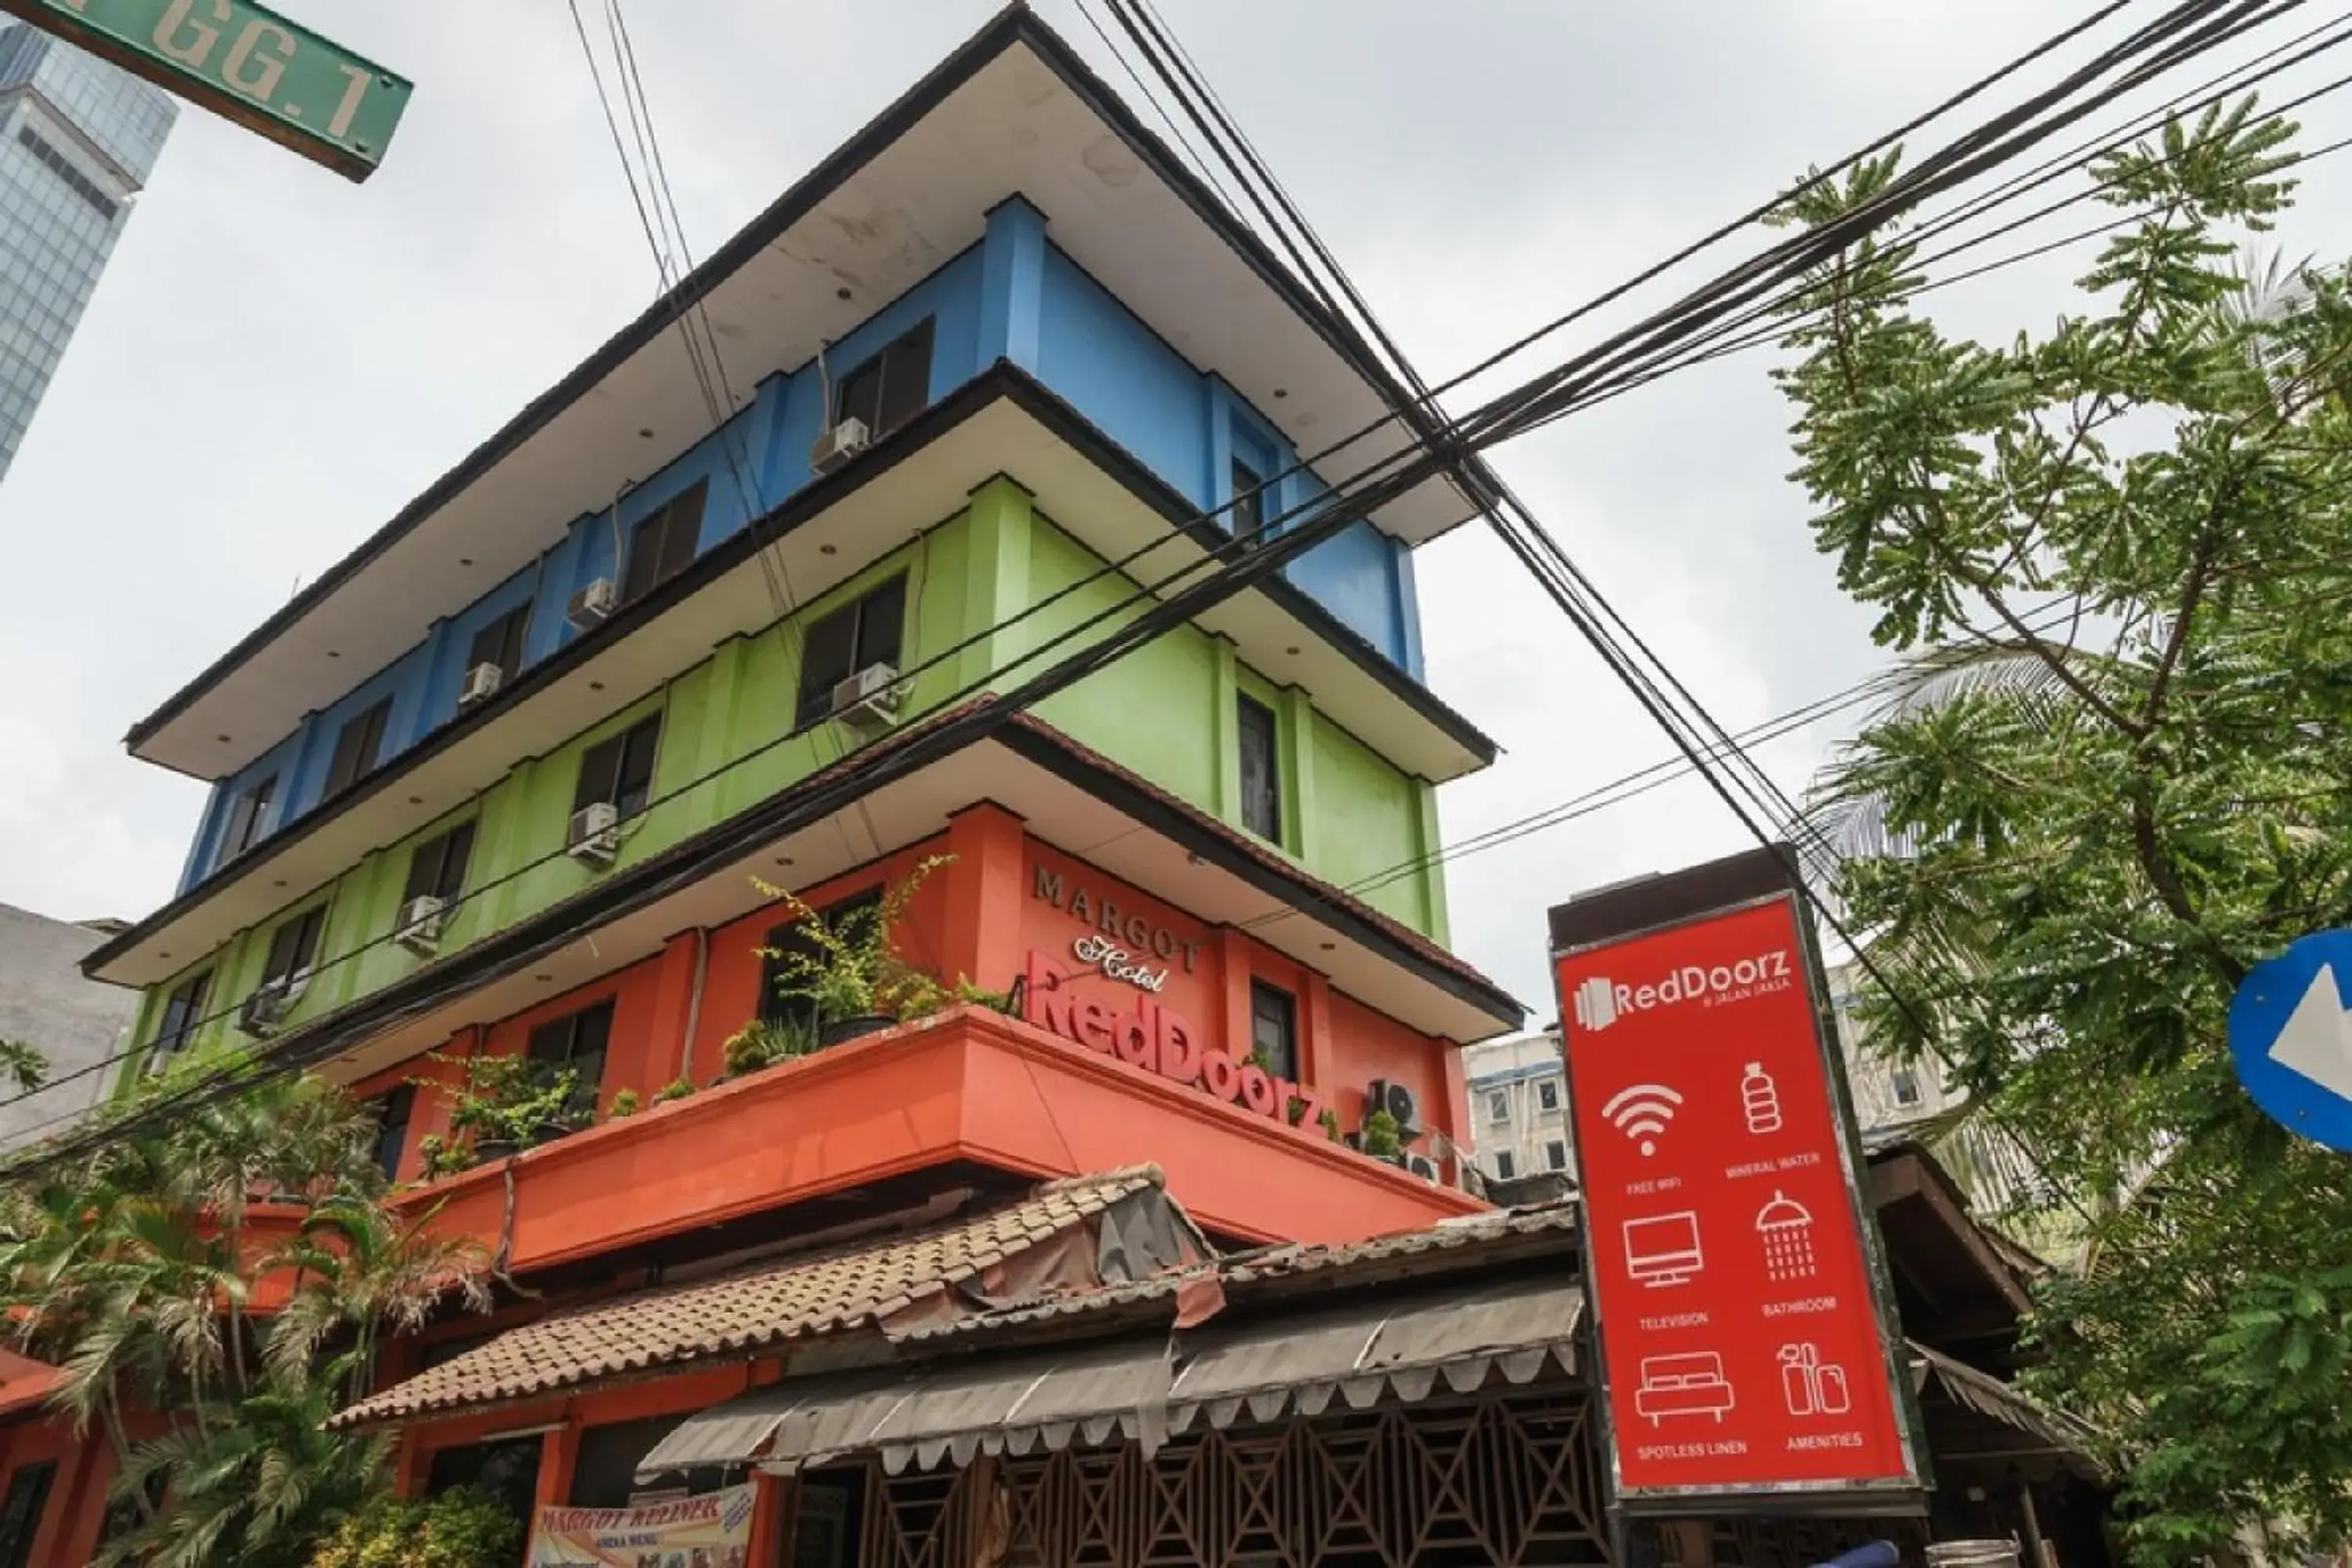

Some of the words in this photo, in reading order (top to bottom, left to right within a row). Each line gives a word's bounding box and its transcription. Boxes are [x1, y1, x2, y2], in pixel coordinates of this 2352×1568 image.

[1033, 864, 1200, 974] MARGOT
[1074, 935, 1169, 993] Hotel
[1616, 949, 1791, 1015] RedDoorz
[1715, 987, 1751, 1007] JALAN
[1025, 949, 1336, 1137] RedDoorz
[1725, 1159, 1777, 1179] MINERAL
[1777, 1152, 1820, 1169] WATER
[1626, 1178, 1657, 1196] FREE
[1762, 1296, 1837, 1317] BATHROOM
[1639, 1312, 1709, 1330] TELEVISION
[1638, 1441, 1705, 1461] SPOTLESS
[1706, 1439, 1748, 1455] LINEN
[1787, 1431, 1863, 1452] AMENITIES
